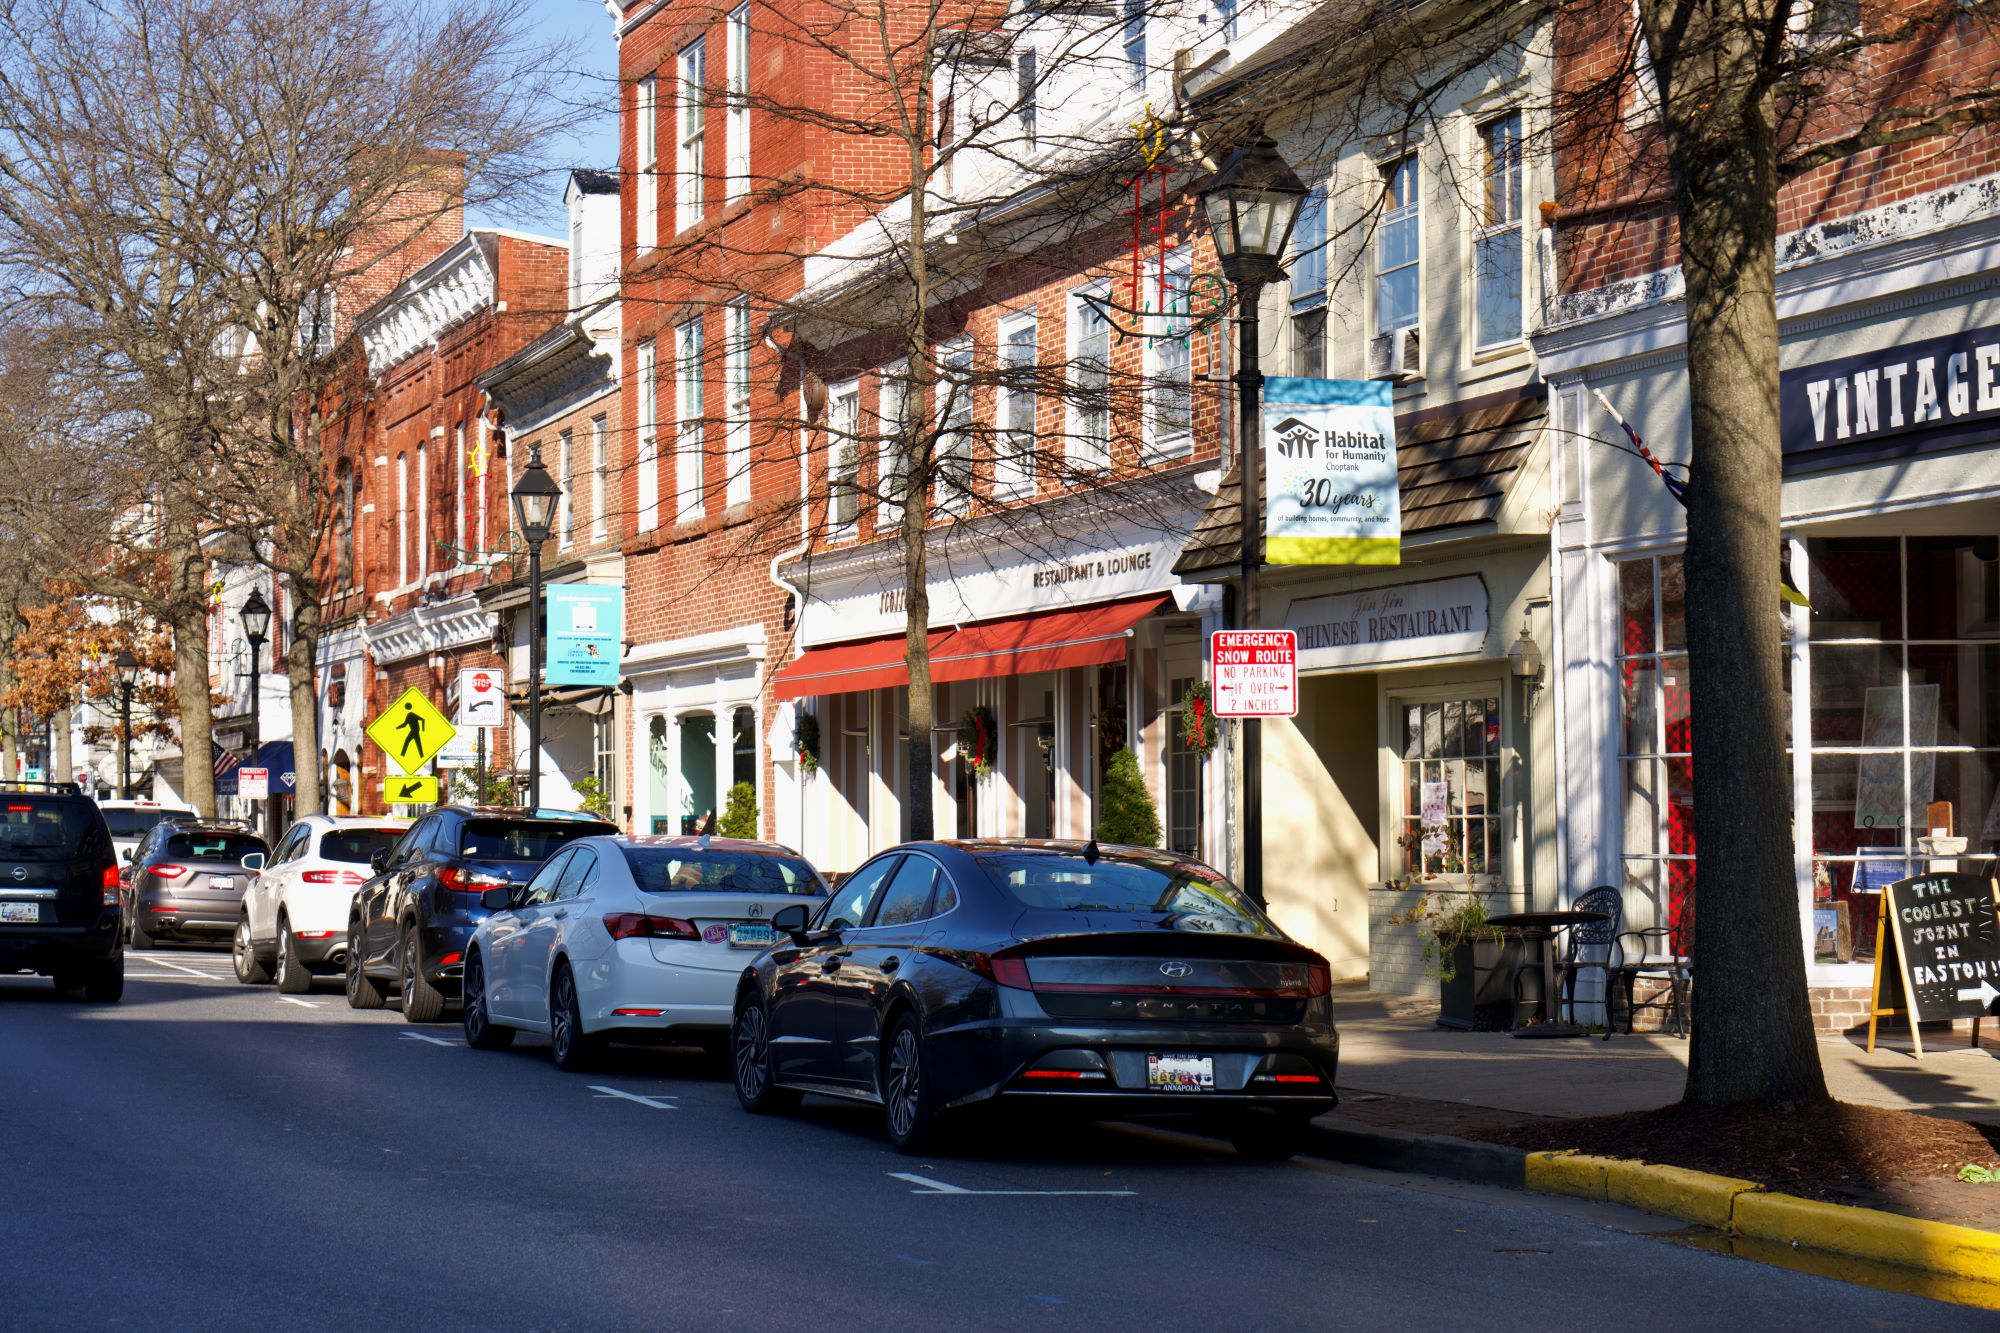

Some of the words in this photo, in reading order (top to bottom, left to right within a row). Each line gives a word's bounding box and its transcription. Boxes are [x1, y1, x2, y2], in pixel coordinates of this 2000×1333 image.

[1806, 343, 2000, 442] VINTAGE
[1324, 430, 1386, 449] Habitat
[1325, 449, 1339, 459] for
[1342, 450, 1386, 463] Humanity
[1325, 462, 1360, 473] Choptank
[1300, 478, 1332, 508] 30
[1332, 493, 1376, 514] years
[1285, 514, 1308, 524] building
[1308, 515, 1329, 523] homes,
[1330, 516, 1363, 524] community,
[1033, 562, 1094, 588] RESTAURANT
[1096, 562, 1105, 577] &
[1107, 552, 1152, 576] LOUNGE
[1297, 620, 1359, 651] CHINESE
[1368, 605, 1473, 643] RESTAURANT
[1219, 633, 1289, 647] EMERGENCY
[1217, 650, 1250, 663] SNOW
[1256, 650, 1293, 663] ROUTE
[1223, 666, 1236, 679] NO
[1243, 665, 1286, 679] PARKING
[472, 678, 491, 687] STOP
[1234, 682, 1243, 695] IF
[1250, 682, 1275, 695] OVER
[1231, 699, 1238, 711] 2
[1244, 699, 1280, 711] INCHES
[1901, 897, 1977, 923] COOLEST
[1913, 922, 1970, 945] JOINT
[1935, 944, 1960, 960] IN
[1913, 959, 2000, 985] EASTON!
[1111, 1000, 1243, 1011] SONATA
[1163, 1084, 1201, 1092] ANNAPOLIS
